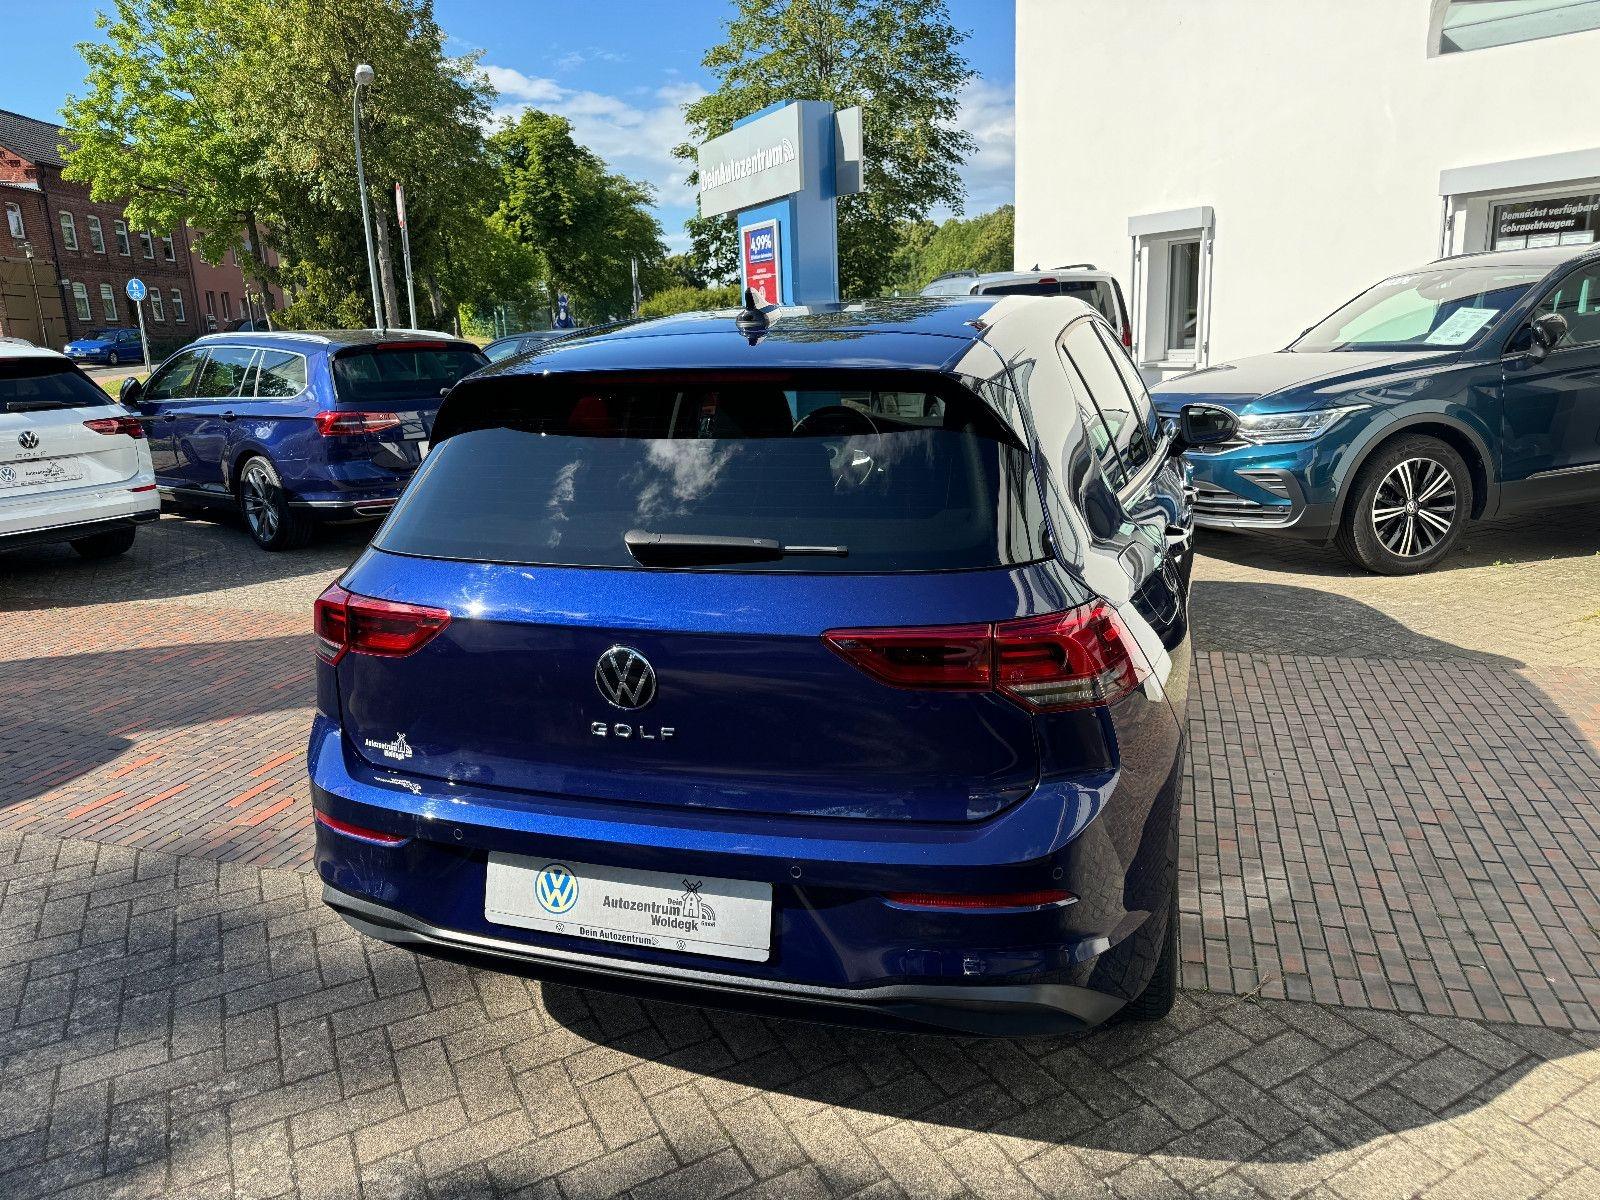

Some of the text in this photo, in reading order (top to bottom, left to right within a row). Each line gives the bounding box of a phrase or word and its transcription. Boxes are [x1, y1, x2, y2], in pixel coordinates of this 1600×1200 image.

[1501, 202, 1599, 220] Demnächst verfügbare
[1501, 219, 1575, 232] Gebrauchtwagen:
[591, 721, 675, 740] GOLF
[603, 895, 680, 916] Autozentrum
[667, 897, 683, 906] Dein
[651, 914, 698, 932] Woldegk
[579, 926, 598, 937] Dein
[599, 930, 651, 945] Autozentrum
